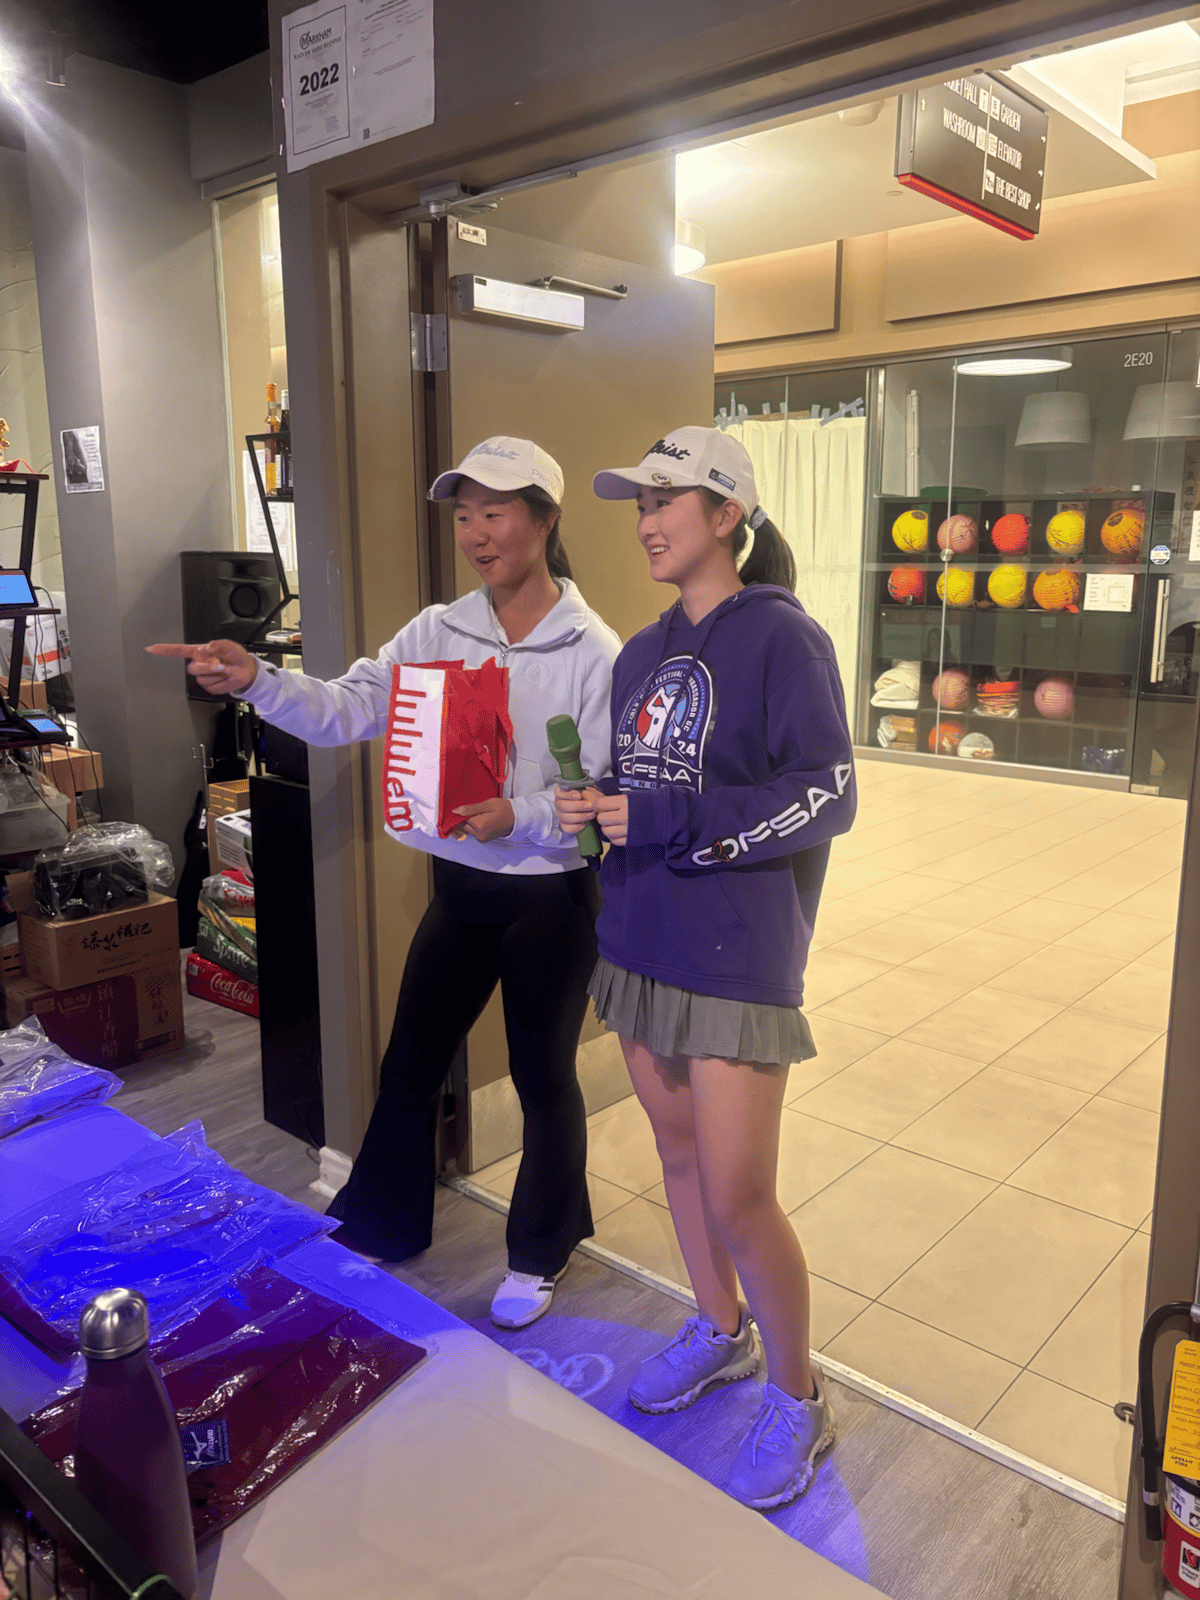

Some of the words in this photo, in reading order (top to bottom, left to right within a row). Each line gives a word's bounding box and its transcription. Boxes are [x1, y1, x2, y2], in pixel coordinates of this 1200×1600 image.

[300, 27, 332, 50] MARKHAM
[299, 63, 339, 97] 2022
[943, 108, 976, 144] WASHROOM
[1001, 104, 1021, 132] GARDEN
[998, 140, 1022, 170] ELEVATOR
[996, 176, 1006, 197] THE
[1005, 182, 1018, 204] BEST
[1018, 189, 1031, 210] SHOP
[1123, 351, 1153, 368] 2E20
[654, 670, 684, 685] FESTIVAL
[619, 734, 631, 747] 20
[683, 719, 693, 733] GC
[676, 740, 697, 757] 24
[692, 762, 852, 866] OFSAA
[213, 938, 249, 968] Sprite
[210, 973, 256, 1004] Coca-Cola
